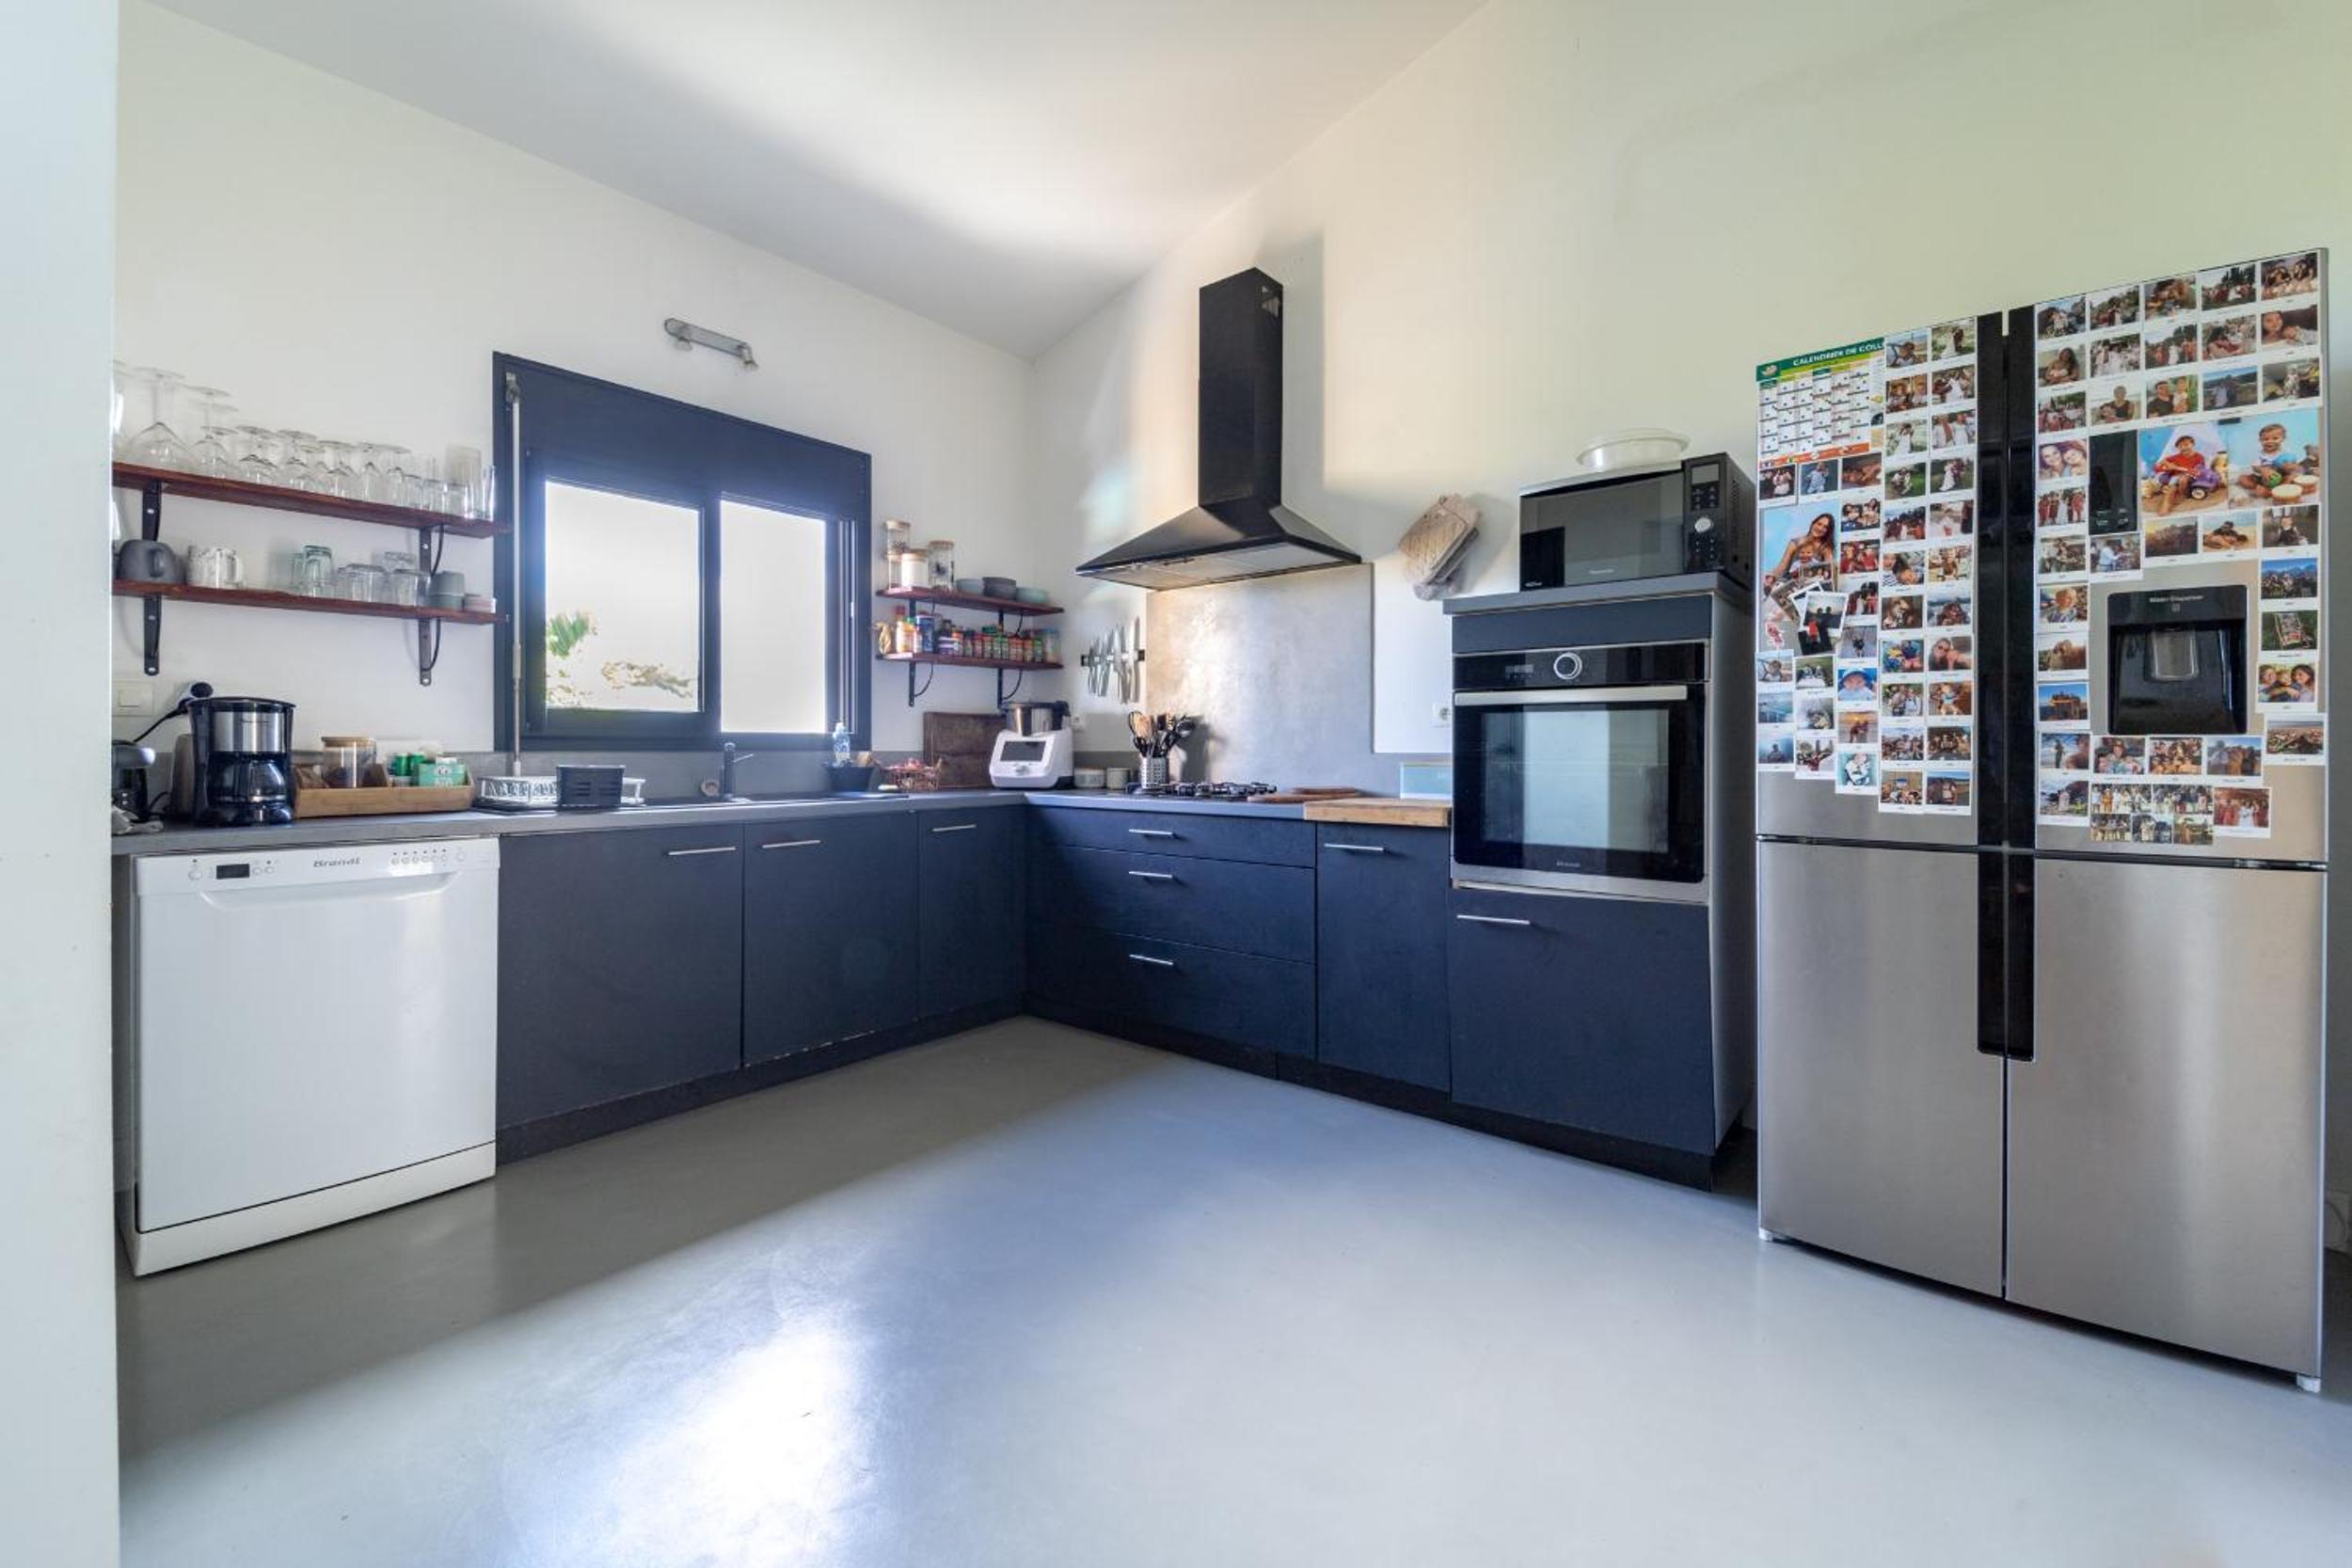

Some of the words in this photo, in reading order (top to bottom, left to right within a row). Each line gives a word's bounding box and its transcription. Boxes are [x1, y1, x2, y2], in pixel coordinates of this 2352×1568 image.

[1793, 351, 1843, 366] CALENDRIER
[1845, 347, 1857, 356] DE
[313, 857, 360, 867] Brandt
